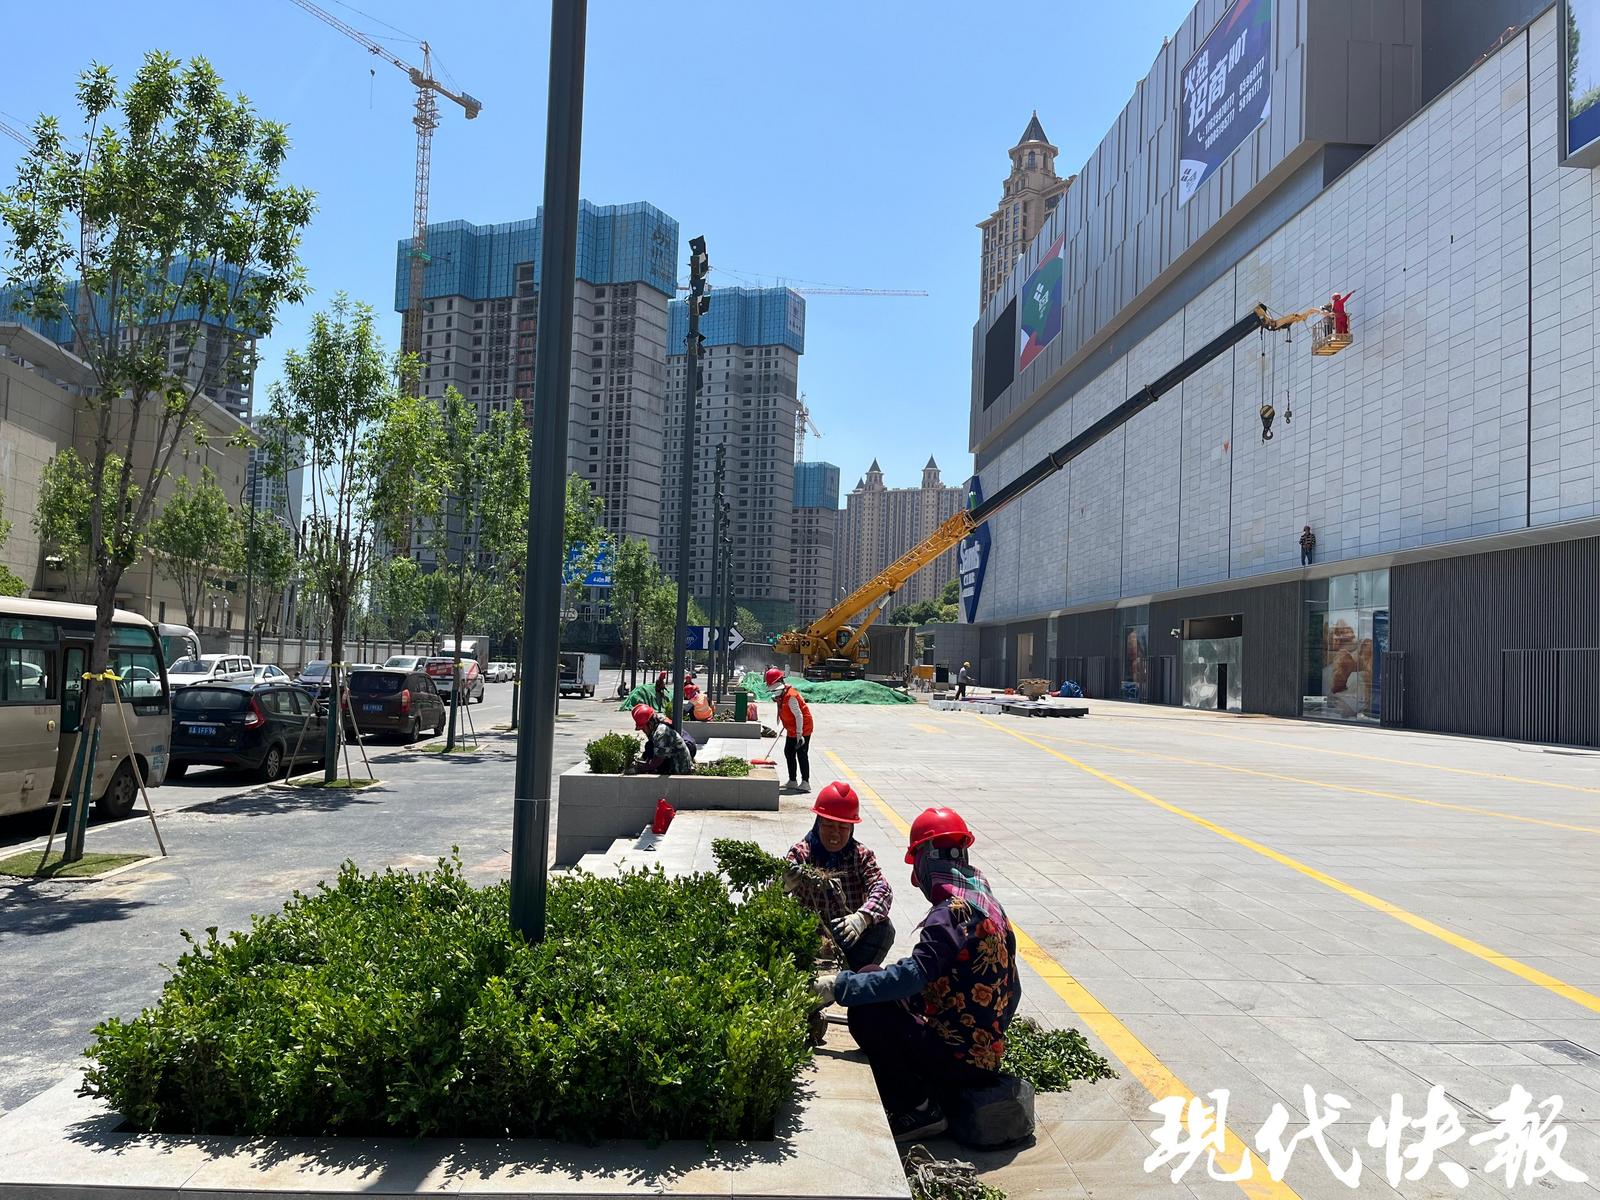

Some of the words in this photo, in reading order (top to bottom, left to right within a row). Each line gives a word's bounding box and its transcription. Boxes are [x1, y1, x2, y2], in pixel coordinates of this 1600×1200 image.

[1183, 49, 1209, 104] 火热
[1188, 53, 1227, 136] 招商
[1228, 28, 1248, 74] HOT
